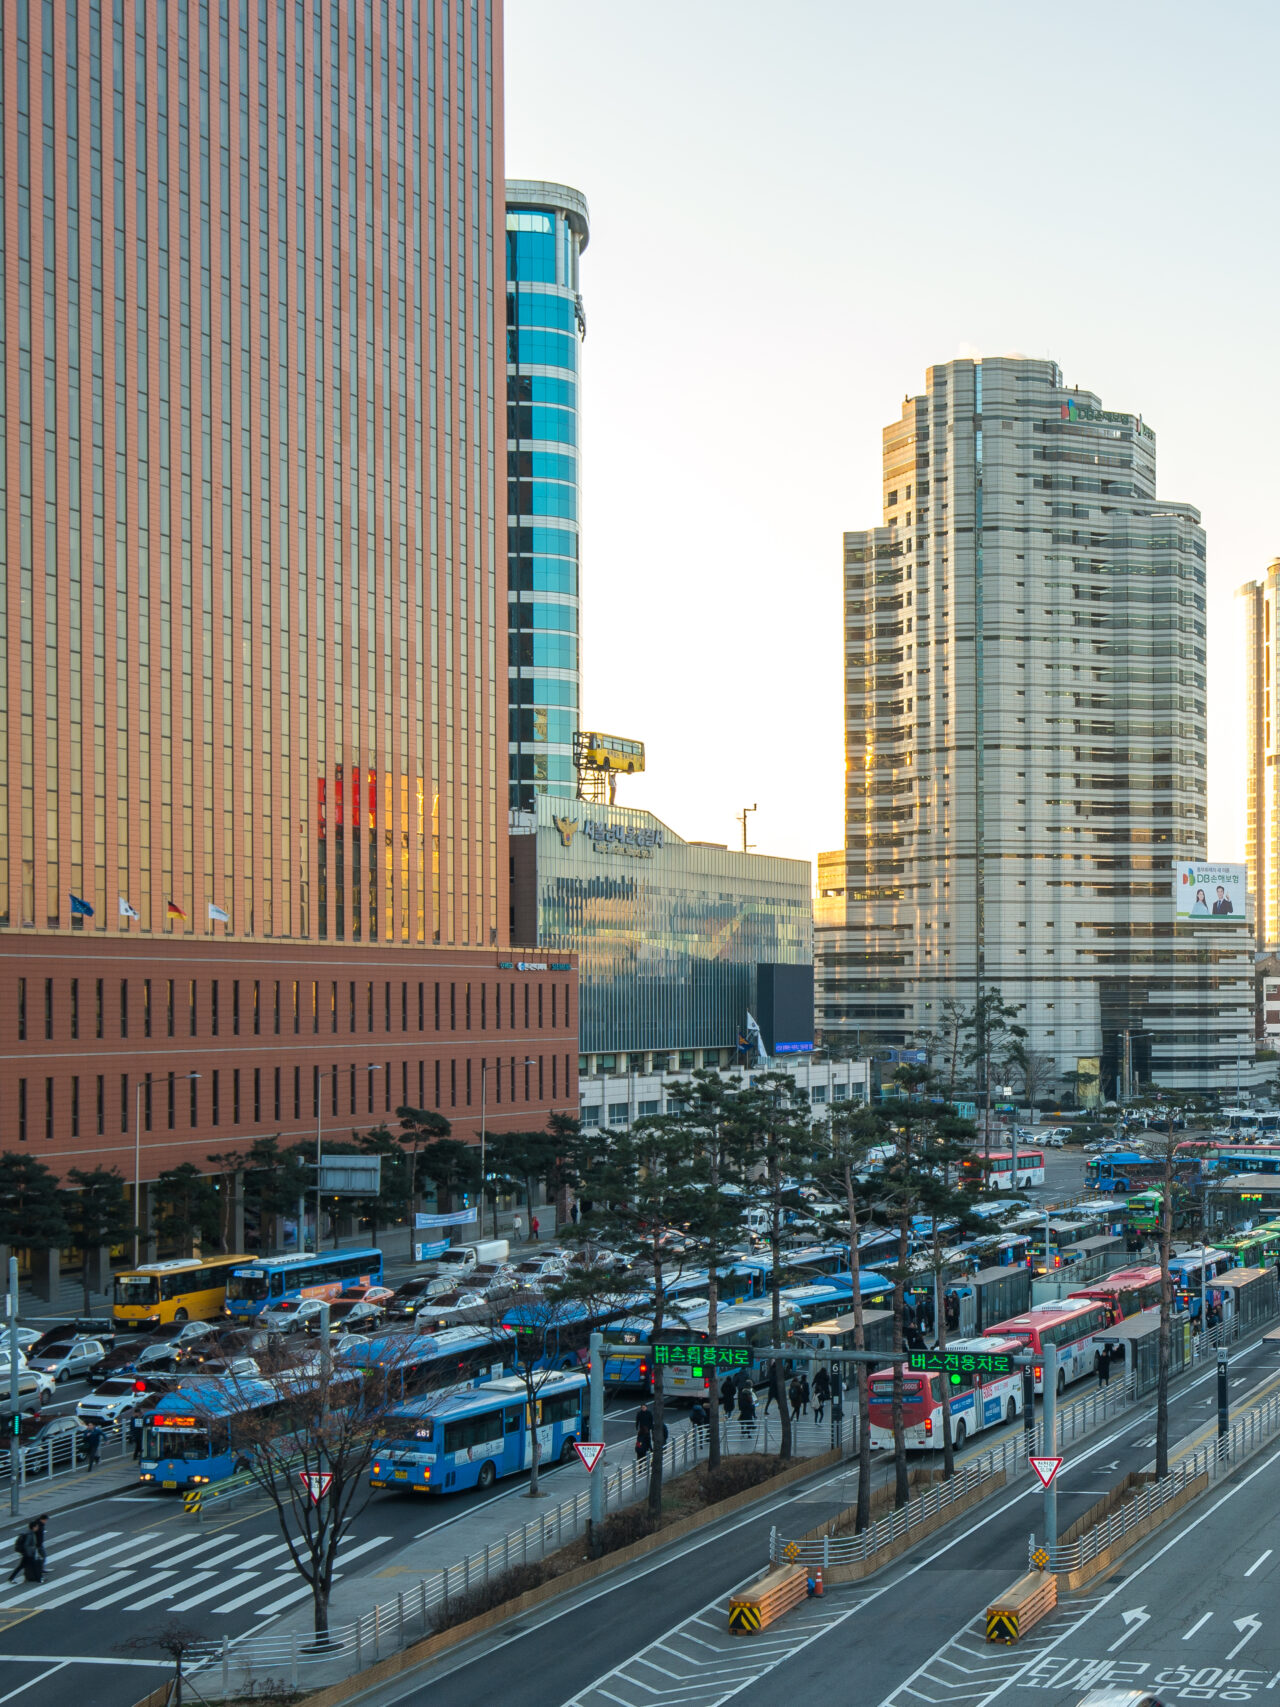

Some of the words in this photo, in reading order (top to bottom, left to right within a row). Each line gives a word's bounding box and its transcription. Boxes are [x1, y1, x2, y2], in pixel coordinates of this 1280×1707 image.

[1196, 874, 1239, 884] DB손해보험
[832, 1362, 839, 1373] 6
[911, 1353, 1010, 1372] 버스전용차로
[1025, 1365, 1031, 1374] 5
[1017, 1656, 1152, 1692] 퇴계로
[1147, 1664, 1264, 1700] 후암동
